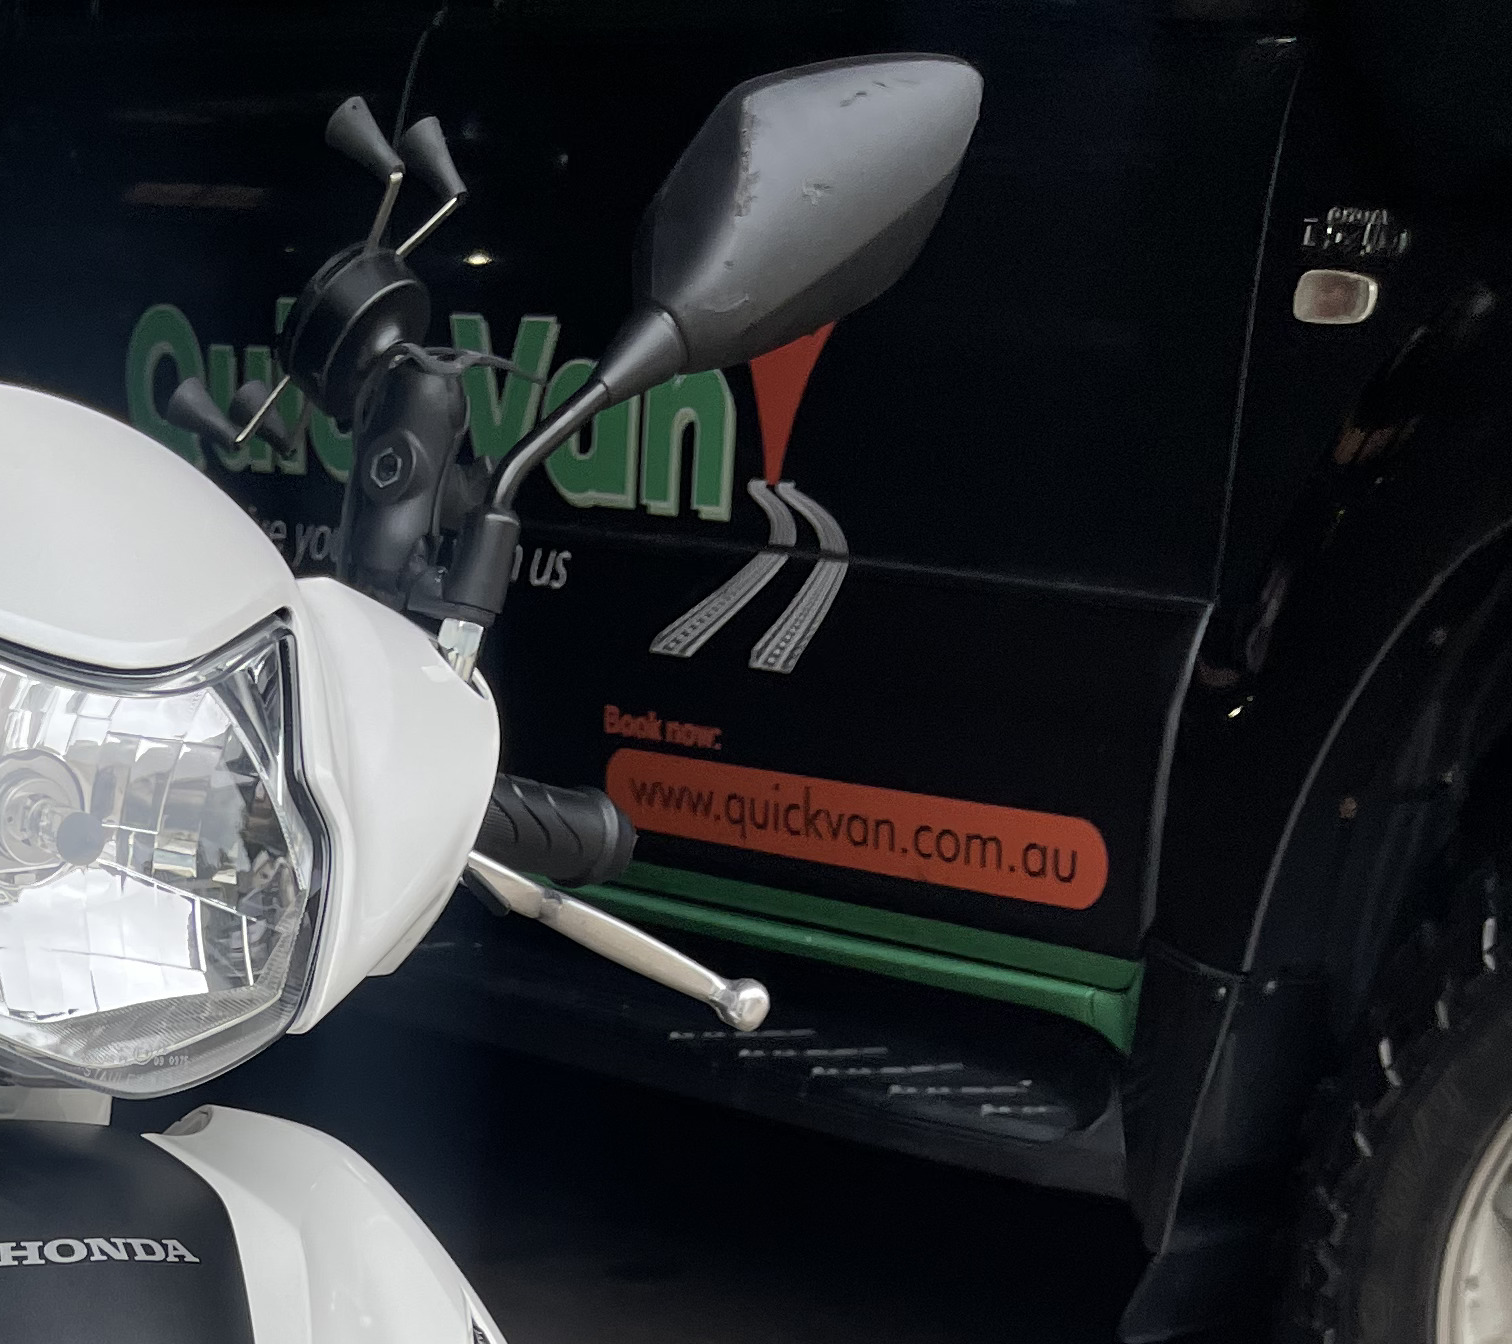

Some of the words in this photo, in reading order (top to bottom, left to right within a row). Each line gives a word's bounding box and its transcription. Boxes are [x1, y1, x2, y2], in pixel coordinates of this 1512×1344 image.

[529, 547, 572, 590] us
[603, 703, 663, 741] Book
[629, 778, 1078, 883] www.quickvan.com.au
